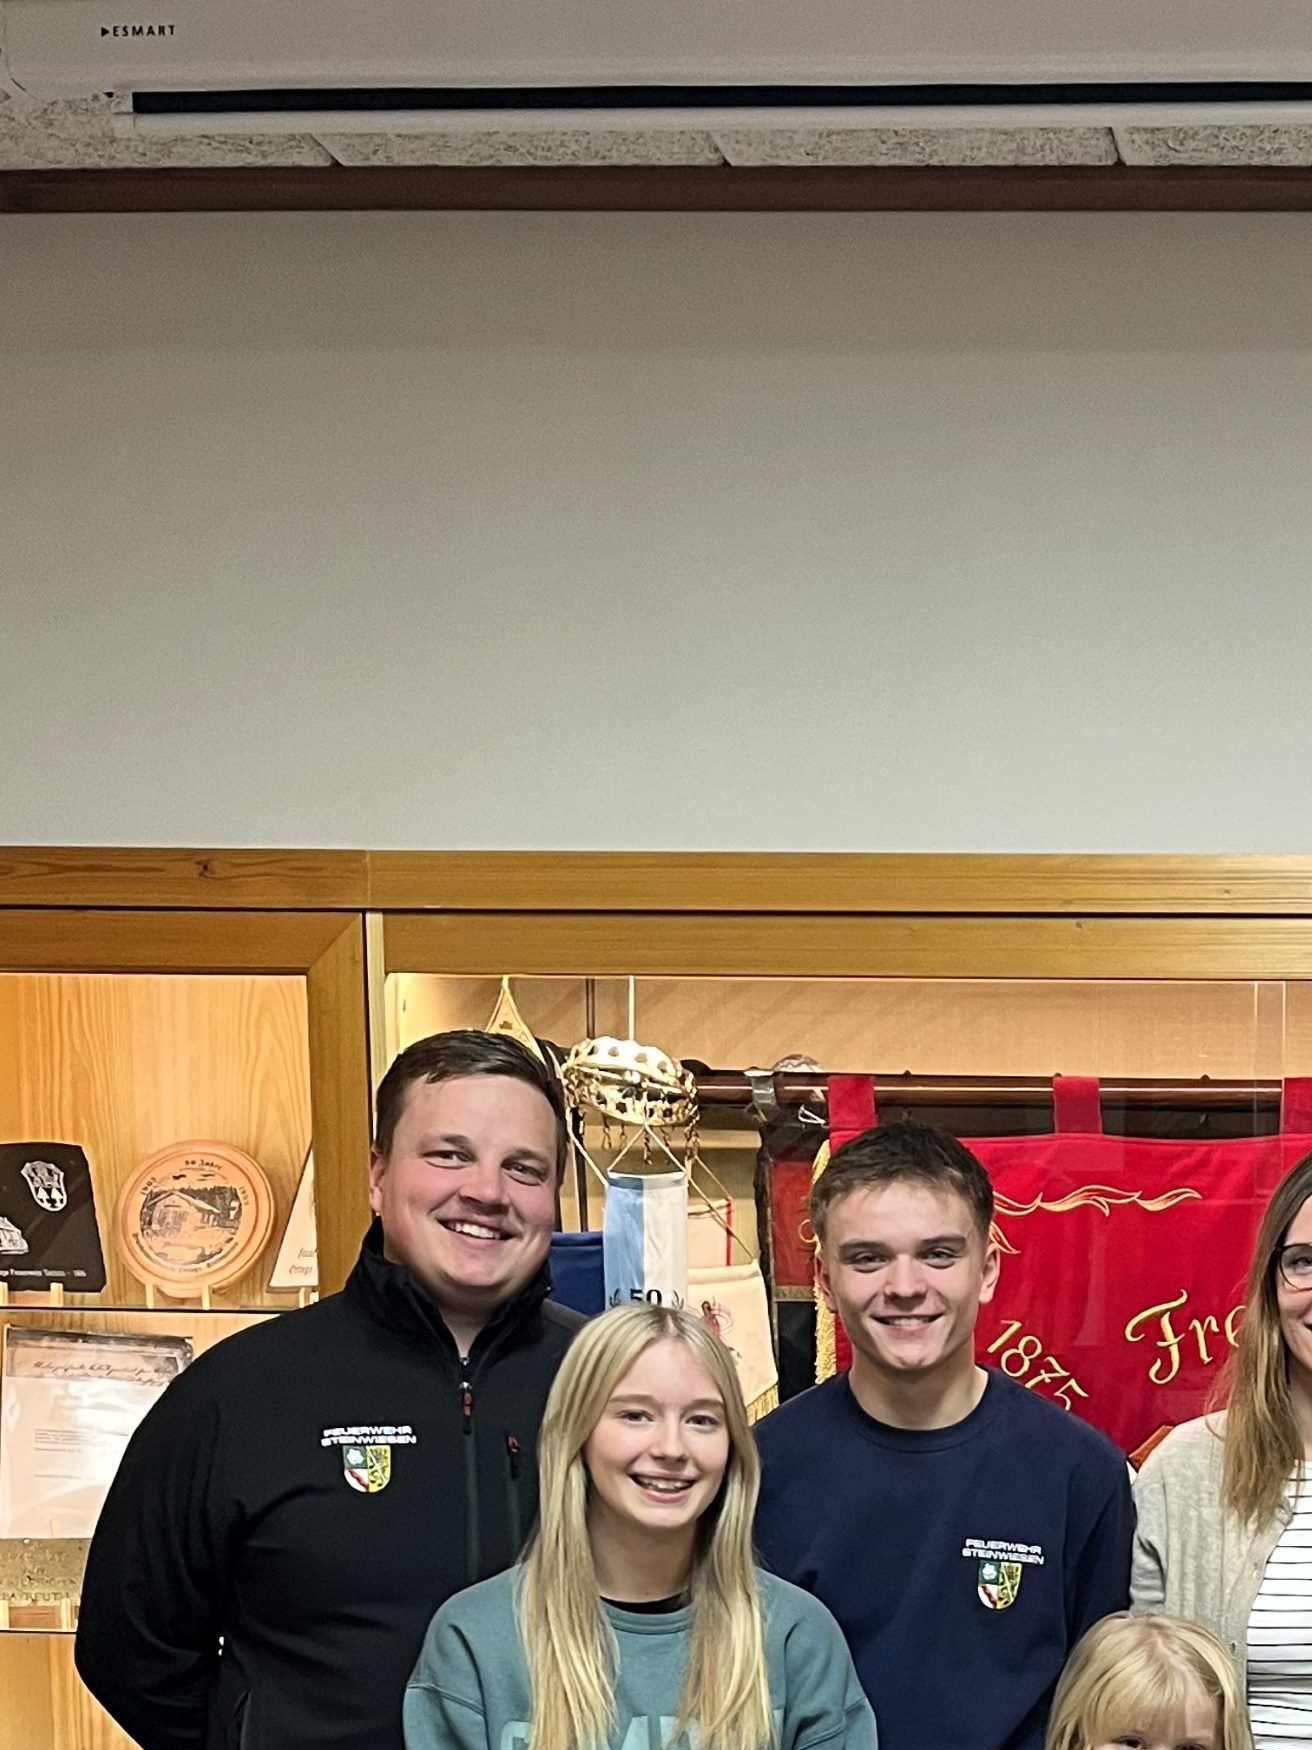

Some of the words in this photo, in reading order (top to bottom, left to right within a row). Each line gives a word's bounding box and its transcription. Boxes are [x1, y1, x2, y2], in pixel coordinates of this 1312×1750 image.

[323, 1426, 412, 1437] FEUERWEHR
[321, 1434, 417, 1447] STEINWIESEN
[965, 1538, 1042, 1555] FEUERWEHR
[962, 1548, 1045, 1565] STEINWIESEN
